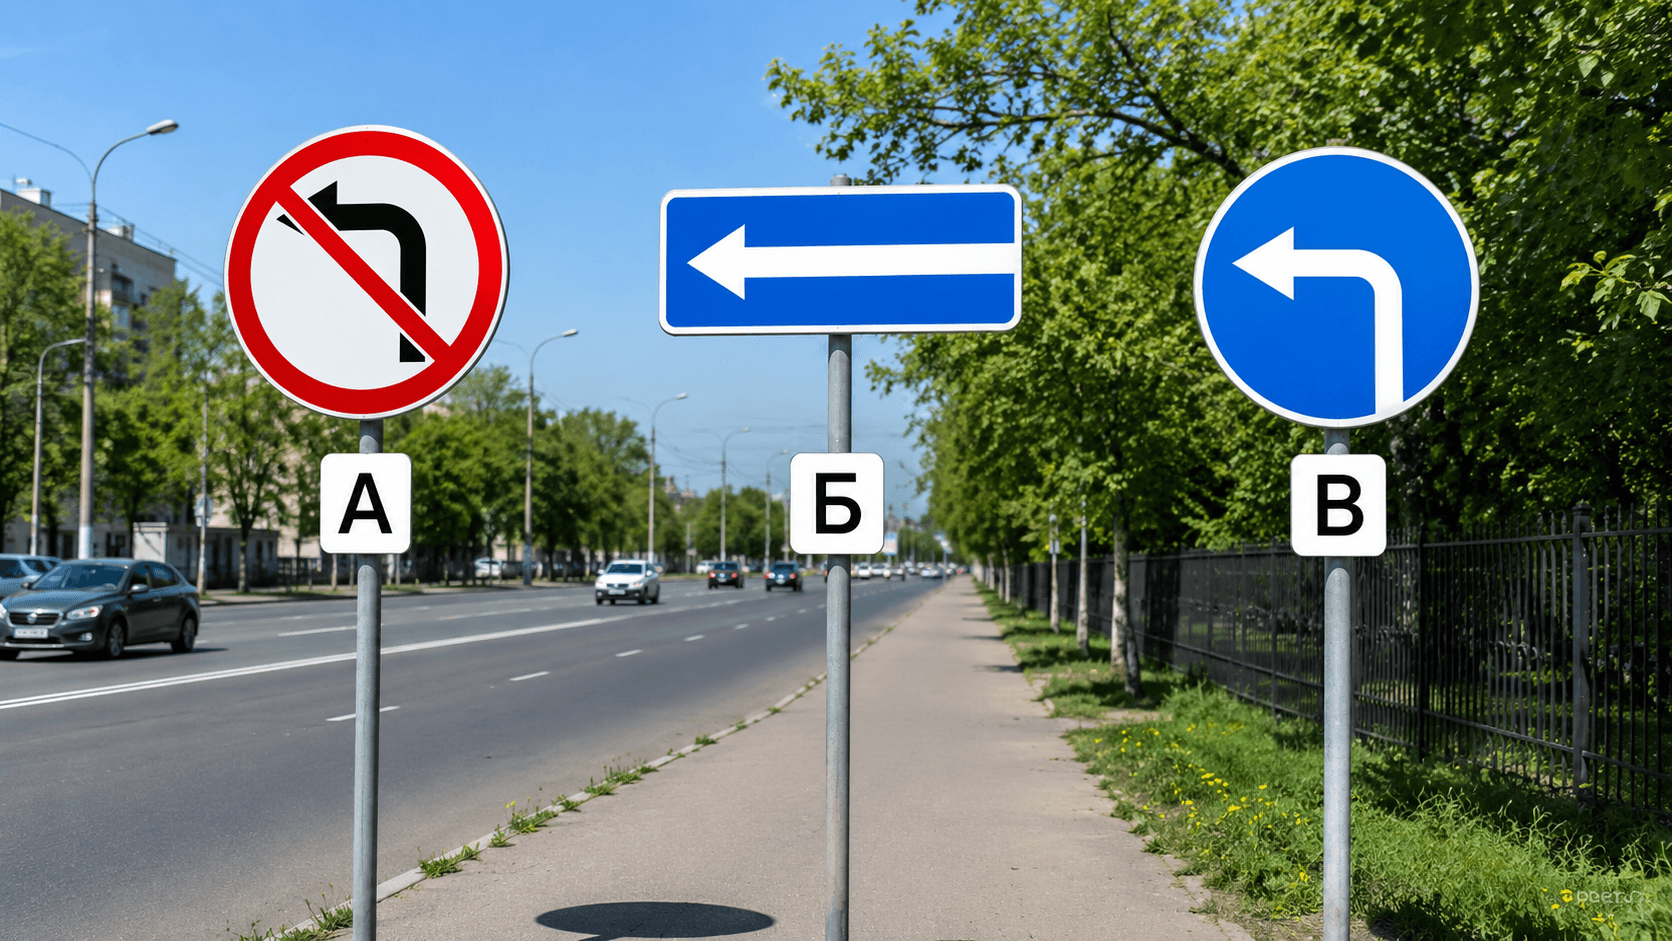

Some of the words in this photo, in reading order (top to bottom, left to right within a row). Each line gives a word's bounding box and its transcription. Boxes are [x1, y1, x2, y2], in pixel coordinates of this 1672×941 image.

[338, 473, 392, 533] А
[816, 473, 861, 533] Б
[1318, 475, 1363, 535] В
